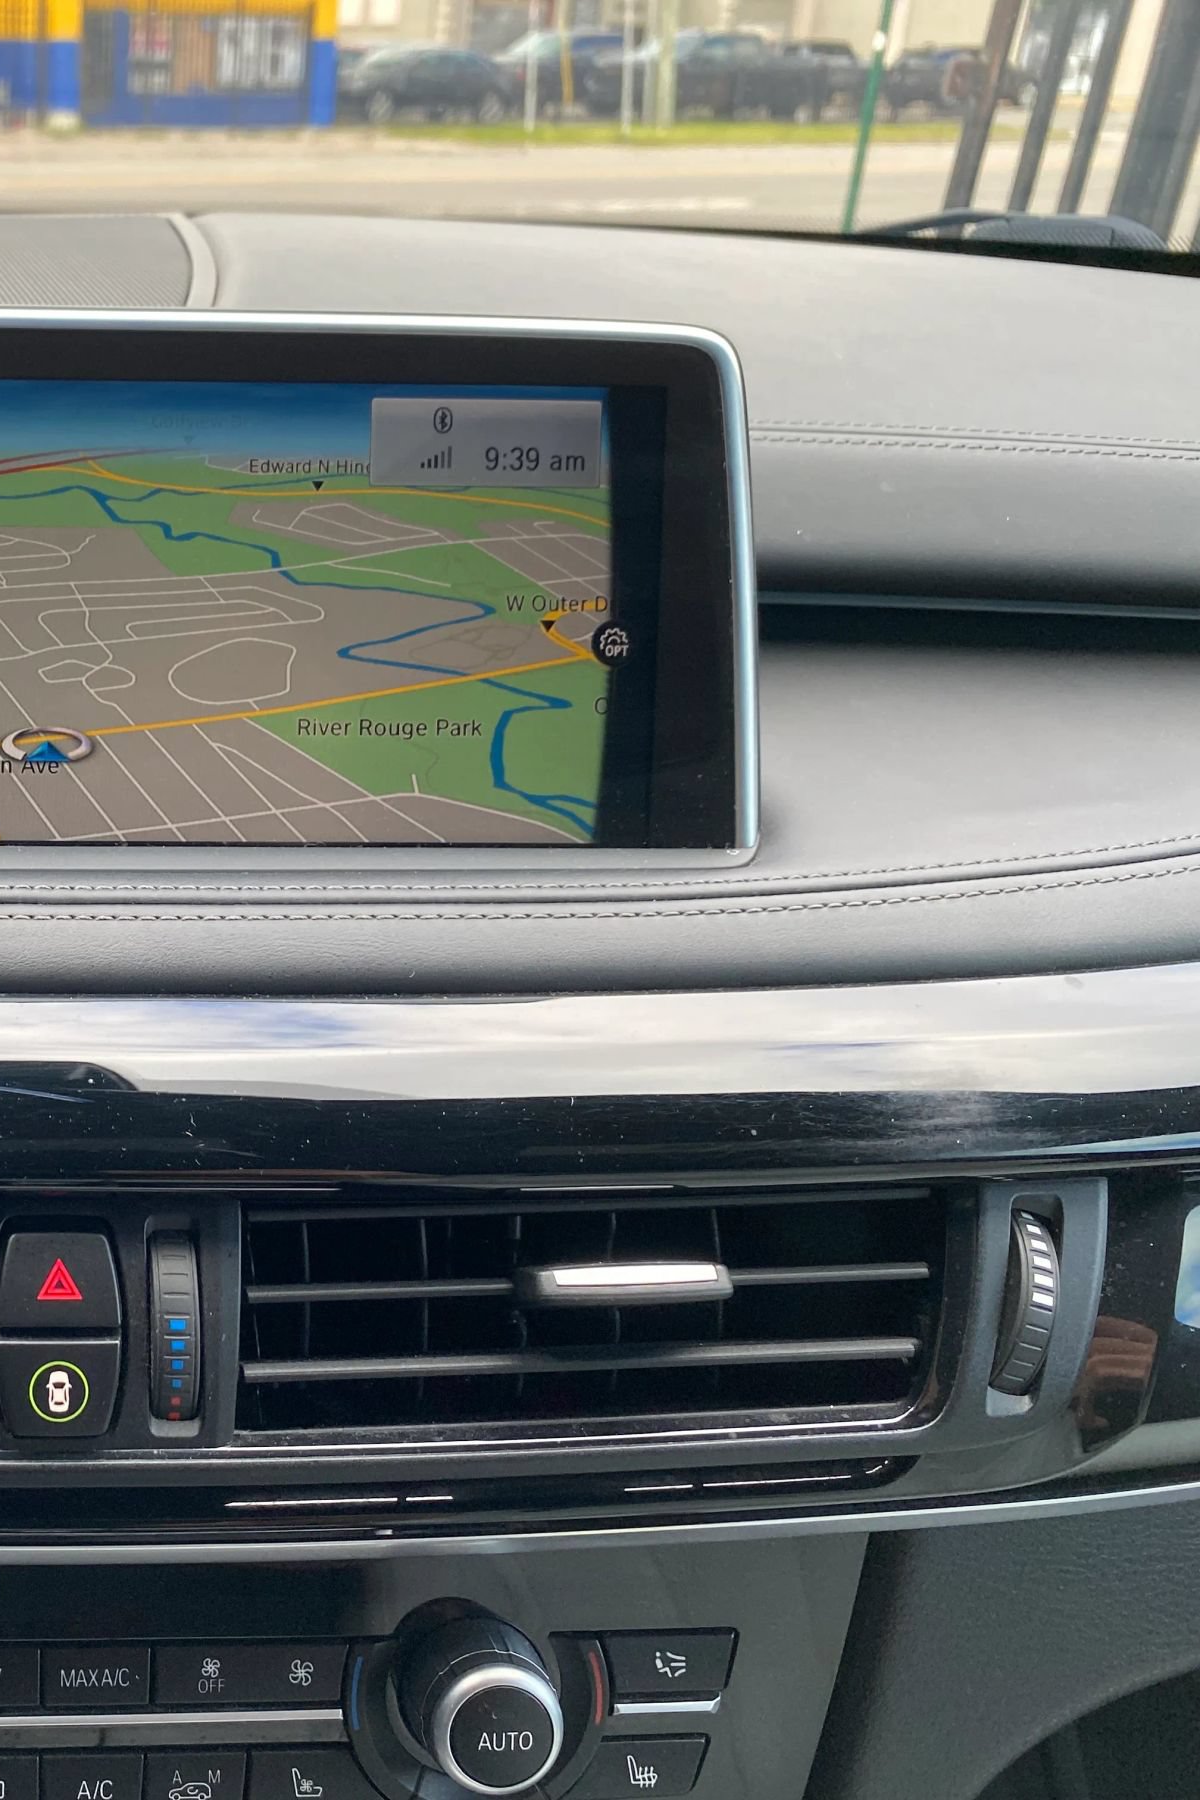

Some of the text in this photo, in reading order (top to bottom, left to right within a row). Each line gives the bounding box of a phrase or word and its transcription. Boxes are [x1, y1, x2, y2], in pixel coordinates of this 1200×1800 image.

[250, 459, 312, 474] Edward
[318, 460, 330, 474] N
[484, 446, 586, 472] 9:39 am
[506, 595, 525, 612] W
[532, 594, 586, 612] Outer
[605, 645, 630, 657] OPT
[297, 718, 482, 740] River Rouge Park
[21, 758, 60, 774] Ave
[197, 1678, 226, 1694] OFF
[477, 1731, 534, 1752] AUTO
[173, 1769, 182, 1784] A
[207, 1769, 221, 1784] M
[76, 1780, 113, 1800] A/C
